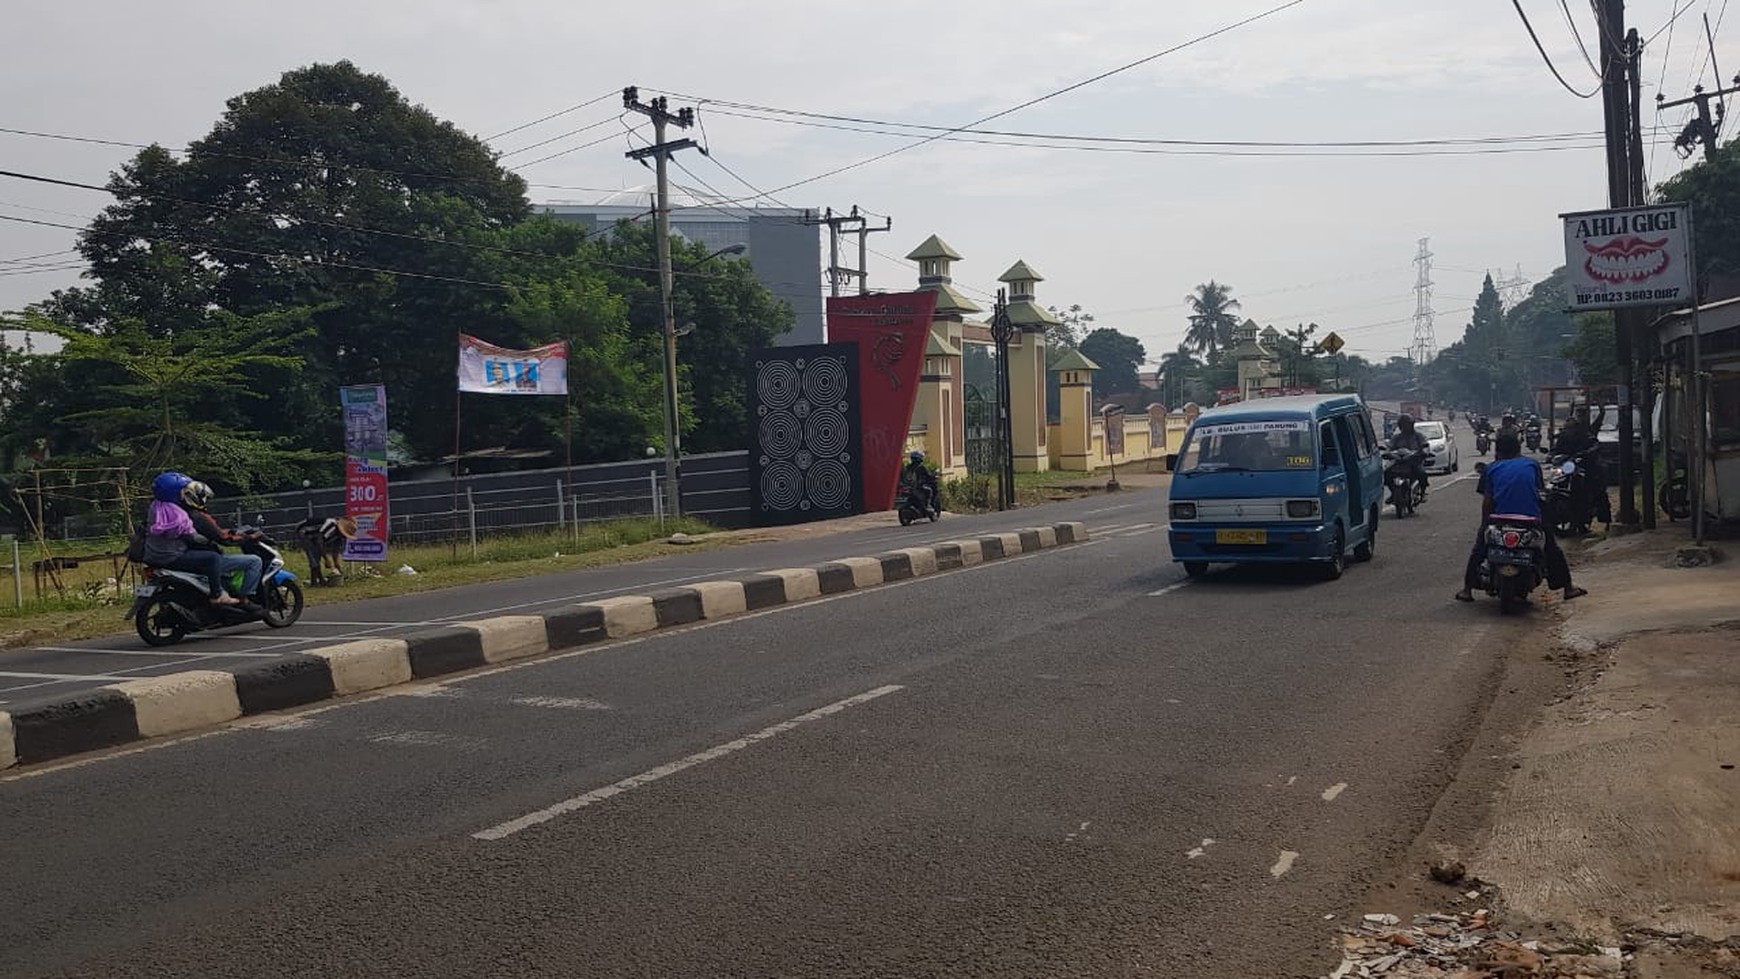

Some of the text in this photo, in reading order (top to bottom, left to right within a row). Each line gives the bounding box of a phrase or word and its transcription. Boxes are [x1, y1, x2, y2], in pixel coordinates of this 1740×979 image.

[1576, 211, 1677, 238] AHLI GIGI
[1625, 290, 1652, 301] 3603
[1654, 287, 1679, 299] 0187
[350, 485, 376, 502] 300
